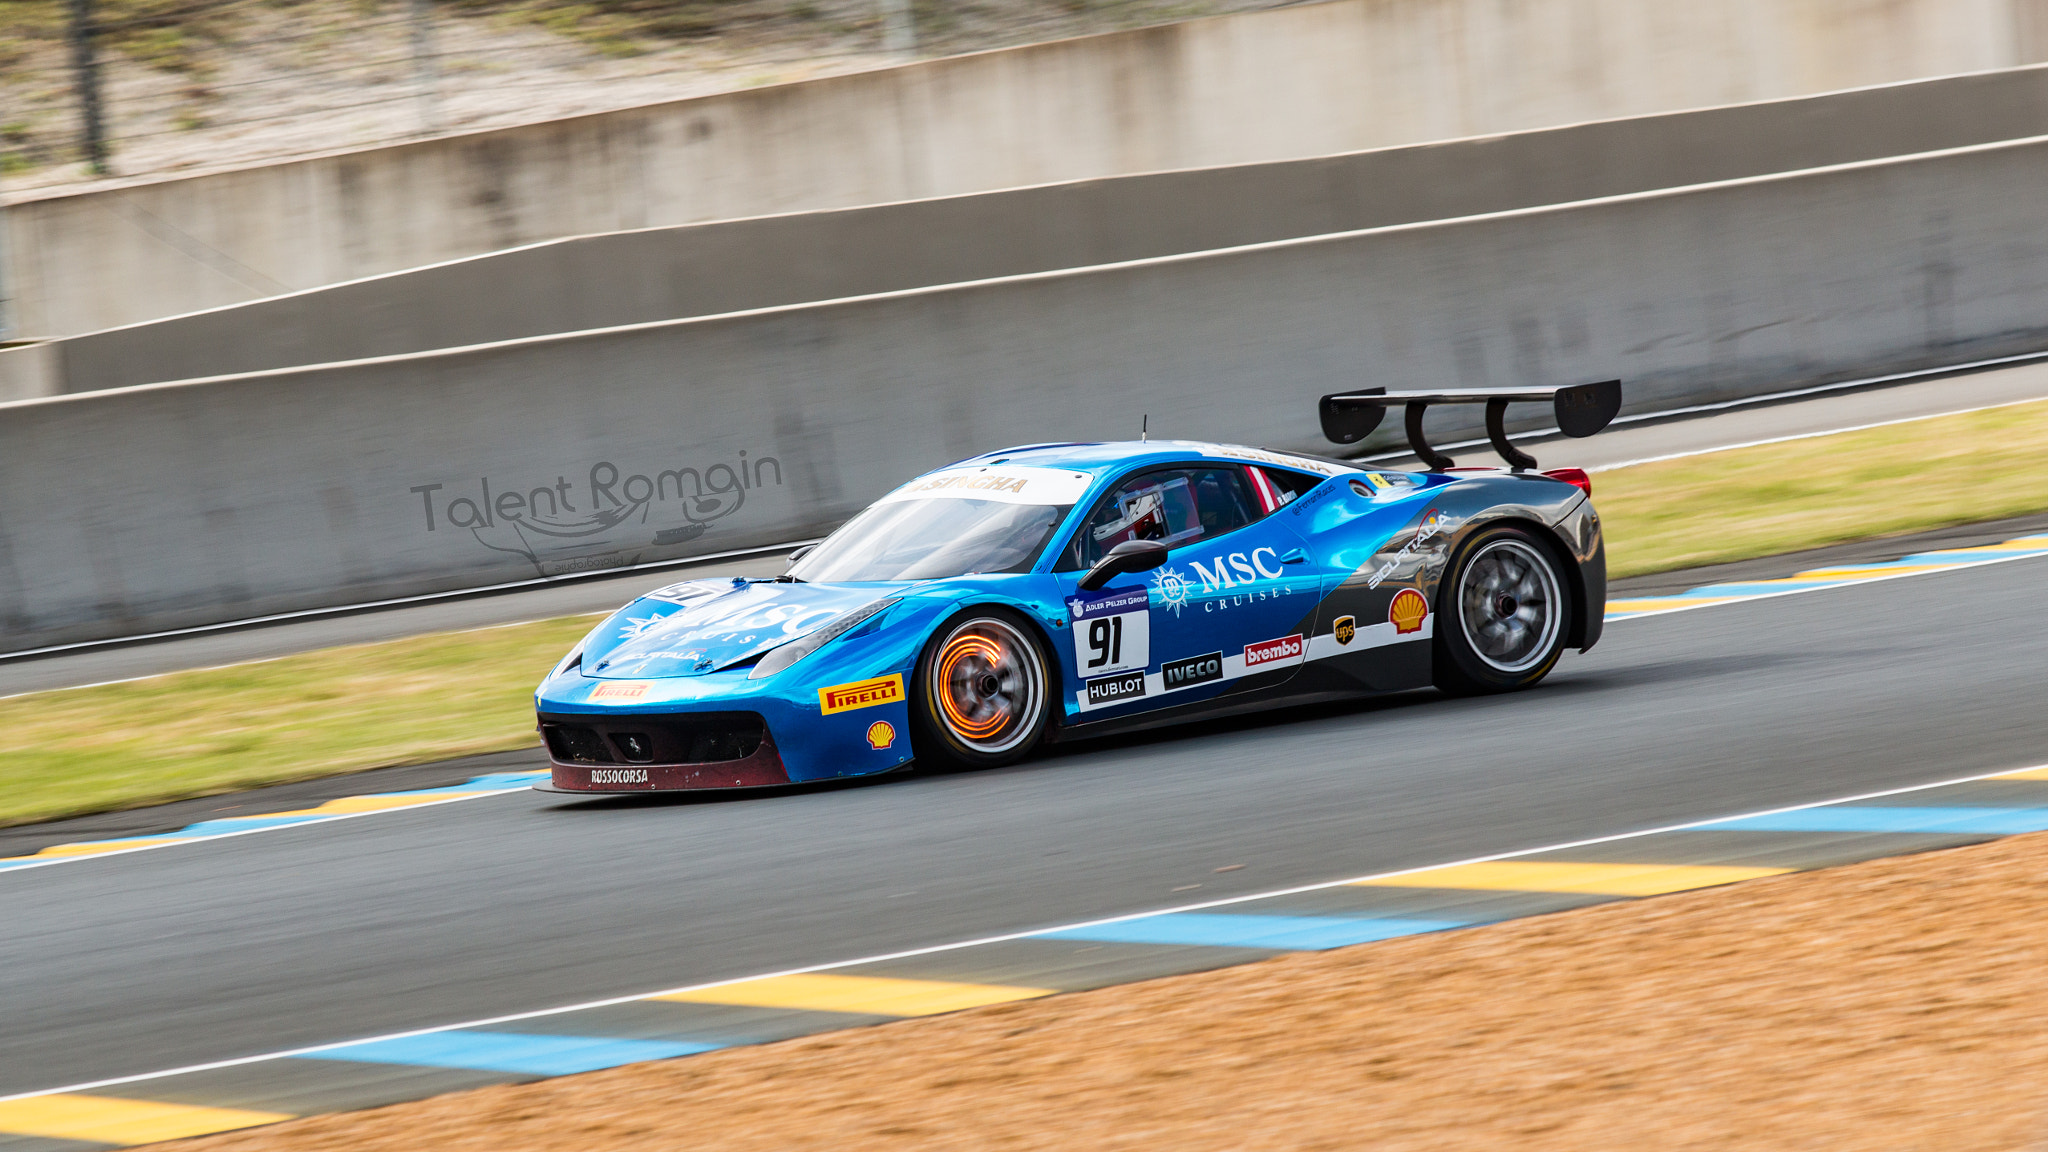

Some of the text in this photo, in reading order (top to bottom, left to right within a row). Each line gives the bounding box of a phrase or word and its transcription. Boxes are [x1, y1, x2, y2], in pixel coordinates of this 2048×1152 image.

[922, 475, 1029, 494] SINGHA
[1367, 514, 1451, 590] SICURITALIA
[1189, 546, 1284, 594] MSC
[1085, 596, 1148, 612] ADLER PELZER GROUP
[1204, 585, 1292, 613] CRUISES
[1088, 616, 1122, 668] 91
[1336, 625, 1354, 641] ups
[1247, 641, 1300, 664] brembo
[1167, 659, 1219, 684] IVECO
[594, 684, 649, 697] PIRELLI
[826, 680, 897, 709] PIRELLI
[1090, 678, 1142, 699] HUBLOT
[591, 769, 649, 785] ROSSOCORSA
